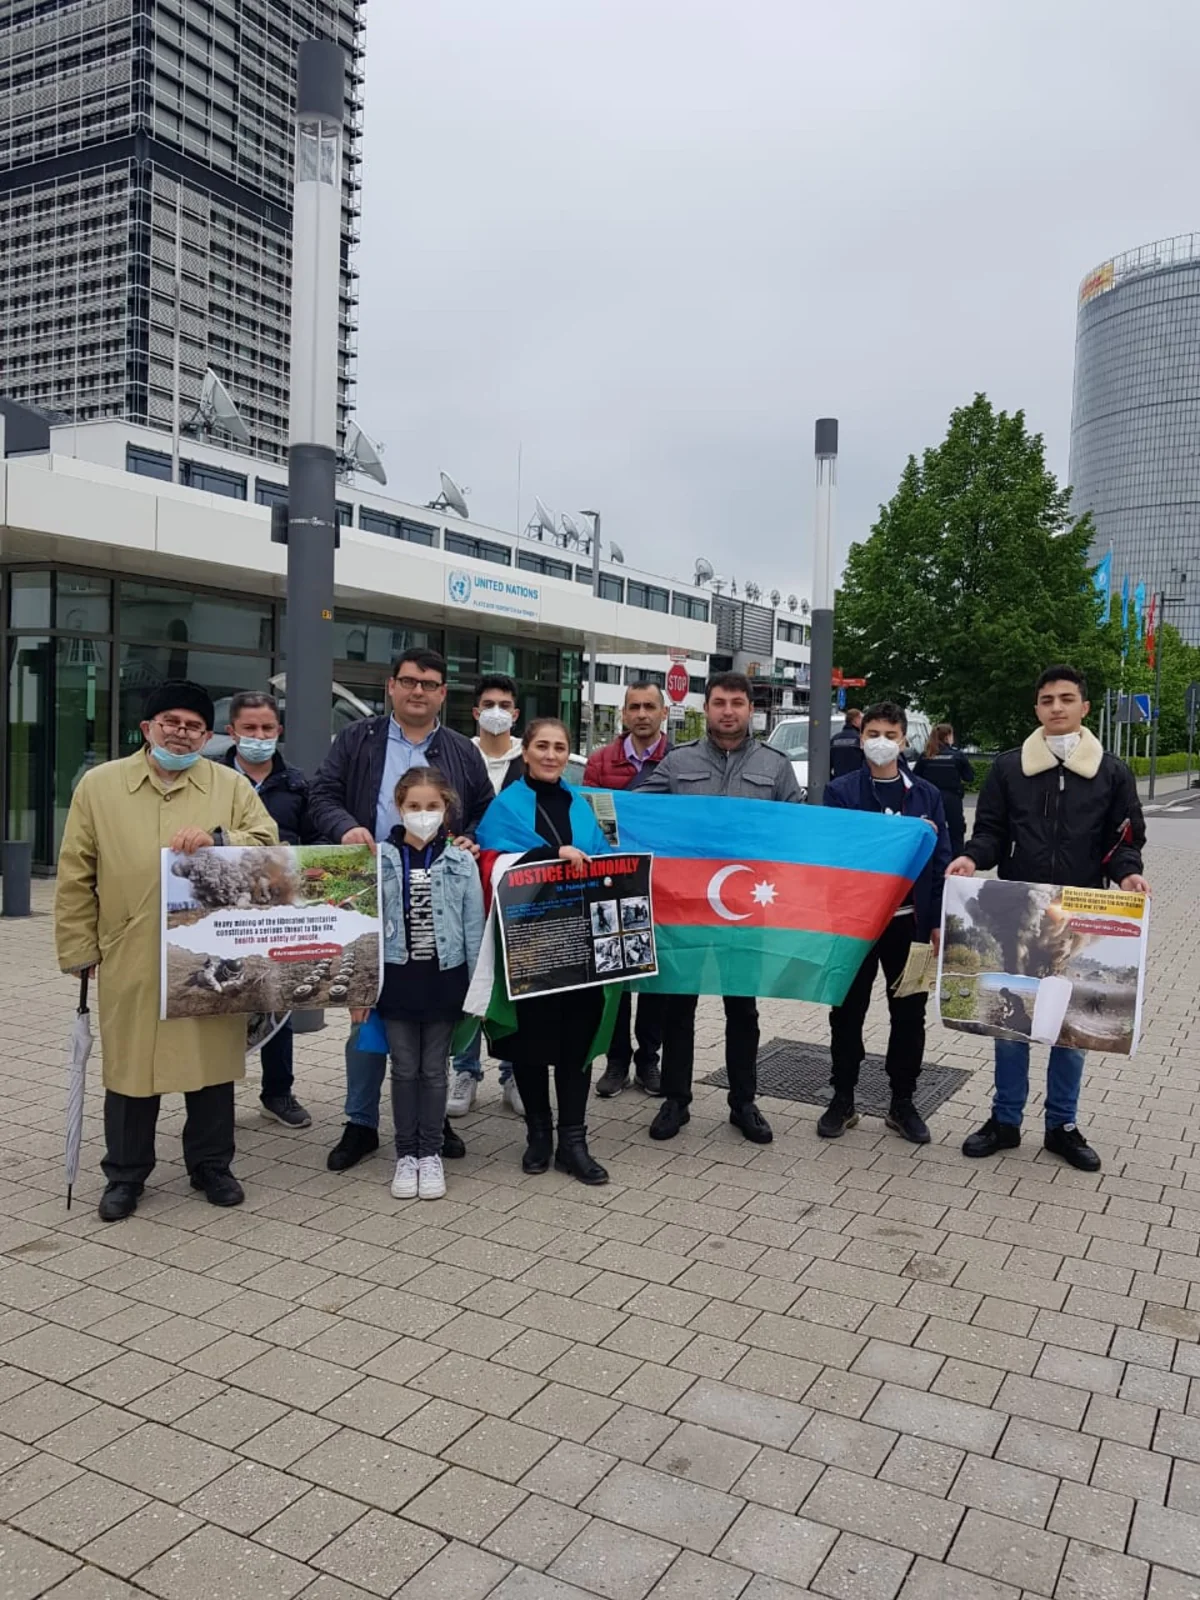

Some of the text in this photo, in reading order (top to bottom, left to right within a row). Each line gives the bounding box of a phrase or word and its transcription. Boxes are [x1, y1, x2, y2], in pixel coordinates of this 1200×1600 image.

[474, 575, 539, 600] UNITED NATIONS
[668, 675, 687, 691] STOP
[508, 858, 640, 888] JUSTICE FOR KHOJALY
[213, 916, 337, 928] Heavy mining of the liberated territories
[409, 868, 436, 961] MOSCHINO
[215, 928, 254, 937] constitutes
[260, 926, 283, 935] serious
[284, 925, 303, 933] threat
[311, 924, 322, 932] the
[234, 936, 256, 945] health
[270, 935, 289, 943] safety
